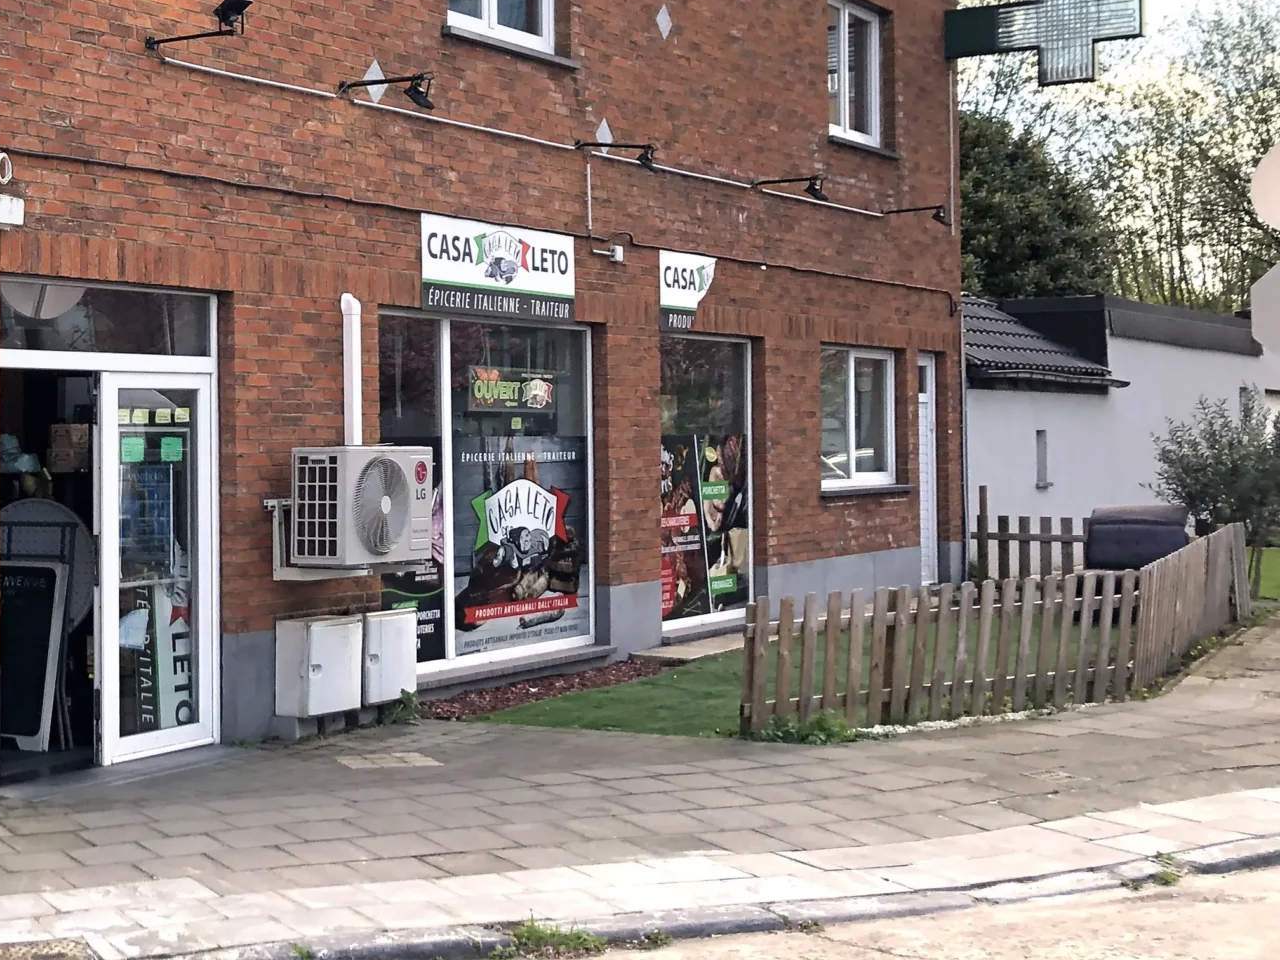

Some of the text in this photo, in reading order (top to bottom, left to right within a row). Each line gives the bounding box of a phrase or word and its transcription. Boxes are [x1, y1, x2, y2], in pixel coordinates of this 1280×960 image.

[427, 232, 569, 275] CASA LETO
[664, 265, 696, 291] CASA
[428, 286, 471, 310] ÉPICERIE
[473, 293, 520, 314] ITALIENNE
[530, 299, 569, 319] TRAITEUR
[668, 313, 695, 329] PRODU
[474, 380, 520, 400] OUVERT
[461, 450, 576, 463] ÉPICERIE ITALIENNE TRAITEUR
[415, 489, 426, 500] LG
[489, 486, 554, 534] CASA LETO
[475, 606, 503, 618] PRODOTTI
[503, 601, 537, 614] ARTIGIANALI
[552, 597, 569, 608] ITALIA
[172, 632, 193, 726] LETO
